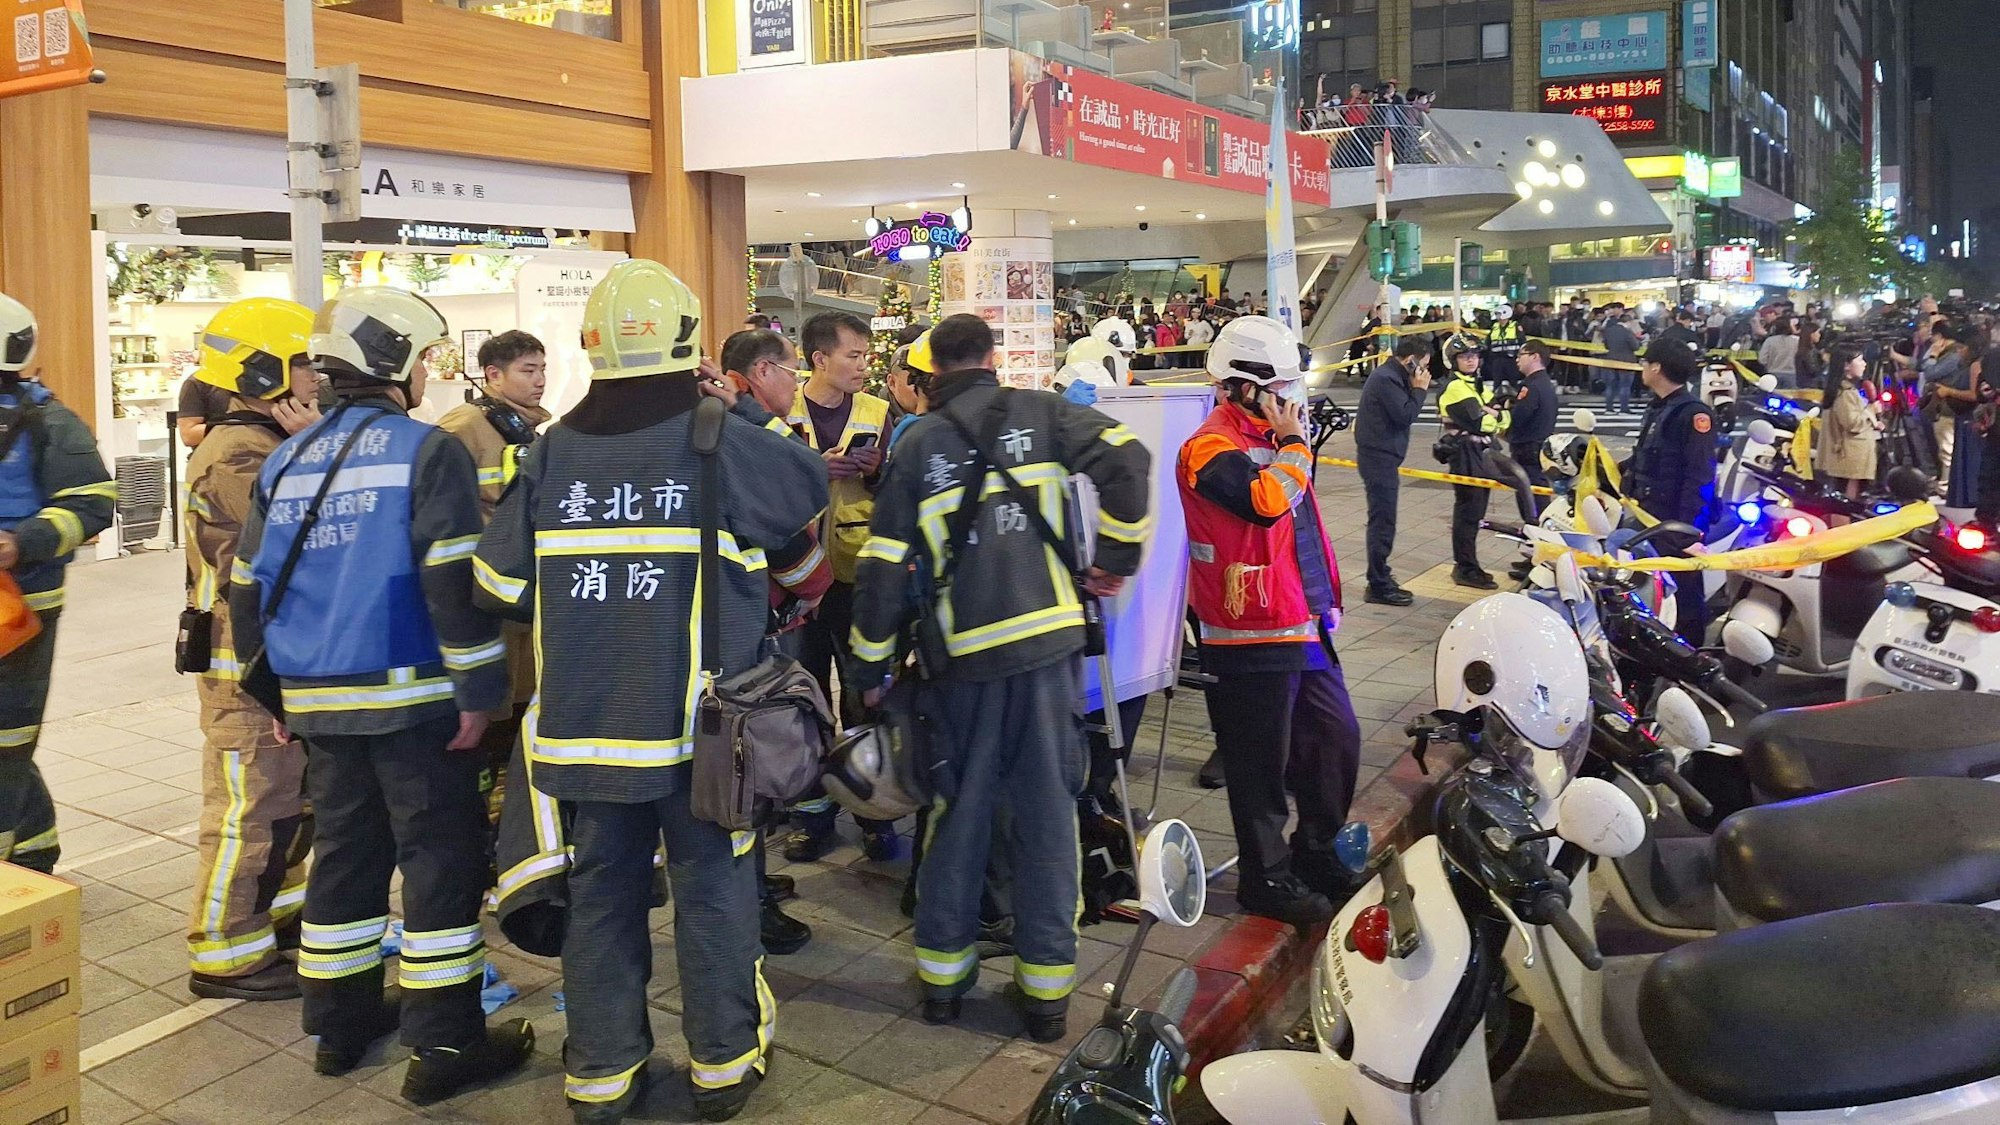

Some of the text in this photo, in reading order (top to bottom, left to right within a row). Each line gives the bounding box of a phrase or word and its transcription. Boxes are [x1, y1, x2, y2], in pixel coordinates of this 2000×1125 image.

[1545, 78, 1662, 103] 京水堂中醫診所
[1079, 131, 1099, 147] Having
[1103, 137, 1116, 149] good
[411, 178, 485, 199] 和樂家居
[912, 225, 929, 243] to
[560, 269, 593, 281] HOLA
[620, 319, 657, 336] 三大
[872, 318, 905, 329] HOLA
[558, 478, 690, 523] 臺北市
[570, 559, 666, 602] 消防
